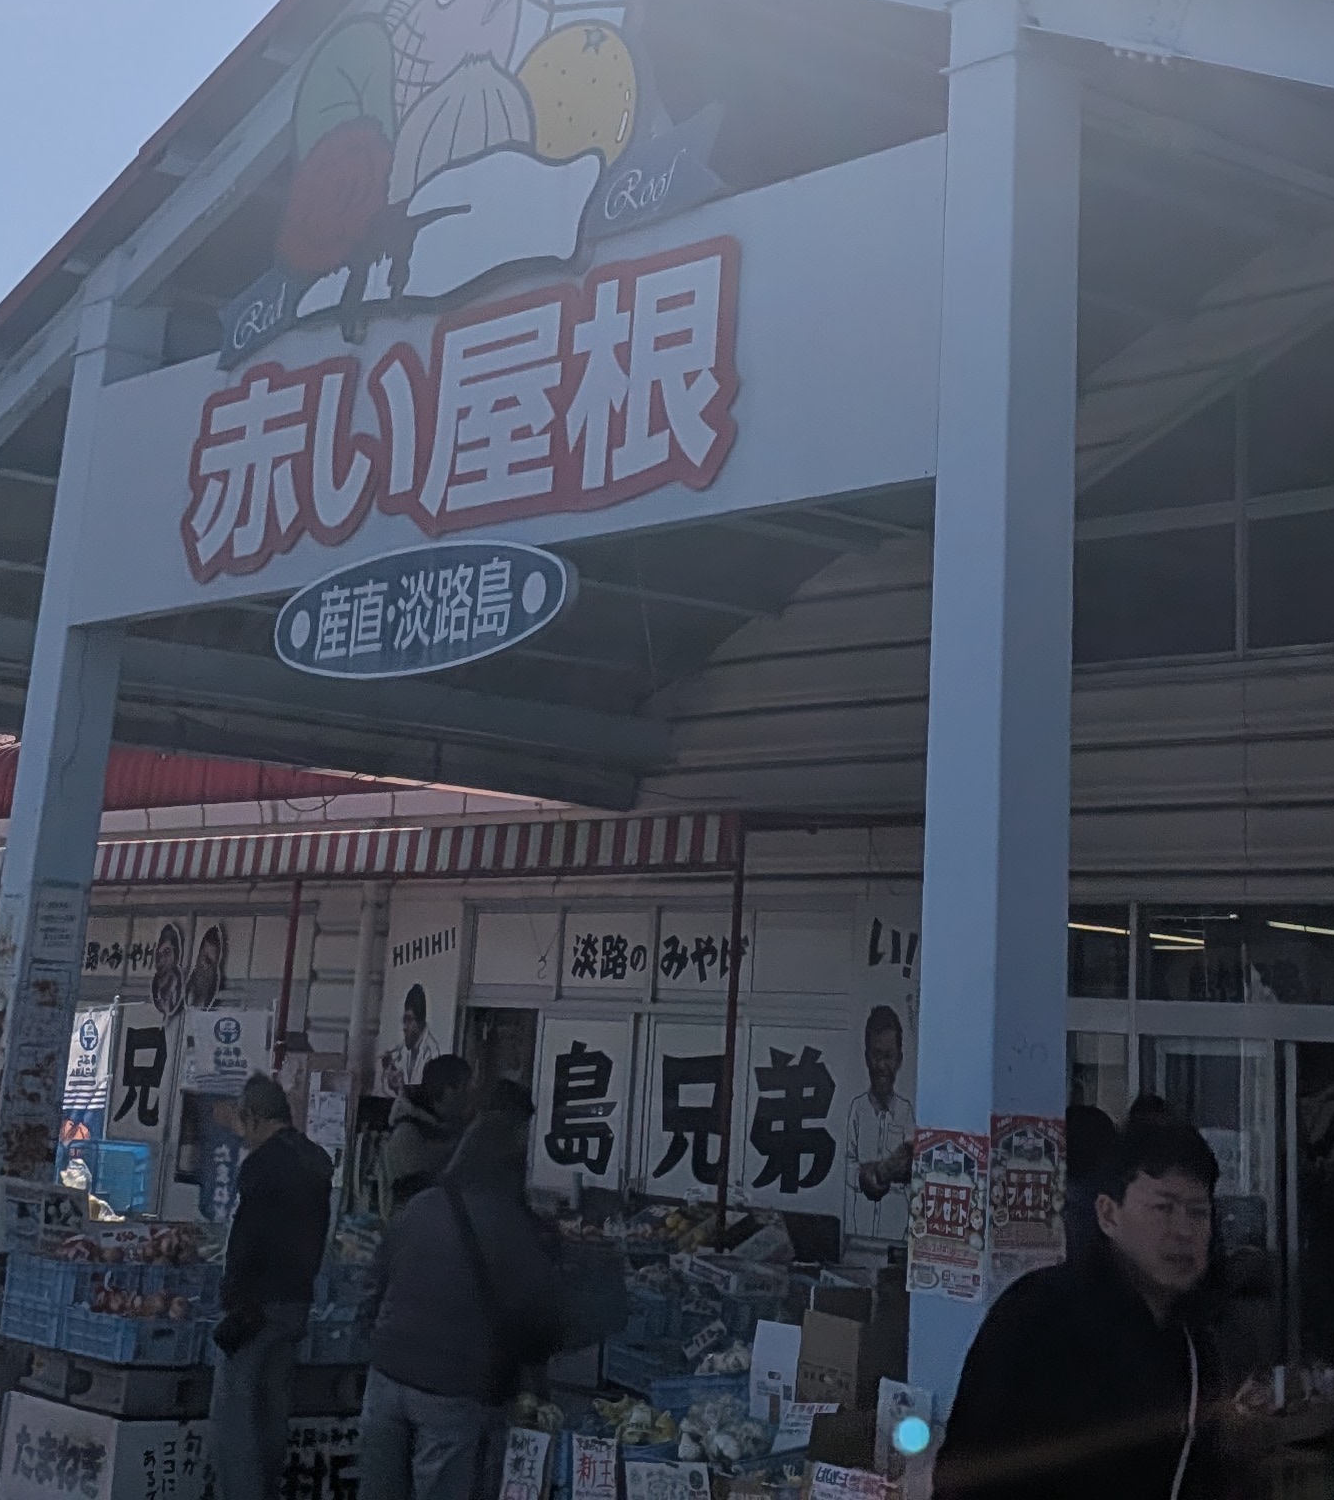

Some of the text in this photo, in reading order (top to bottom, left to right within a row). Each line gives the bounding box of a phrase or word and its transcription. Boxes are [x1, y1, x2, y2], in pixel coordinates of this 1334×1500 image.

[232, 281, 286, 351] Red
[187, 243, 732, 572] 赤い屋根
[313, 555, 514, 660] 産直・淡路島
[392, 926, 457, 968] HIHIHI!
[571, 931, 750, 982] 淡路のみやげ
[543, 1040, 838, 1195] 島兄弟
[12, 1424, 107, 1498] たまねぎ
